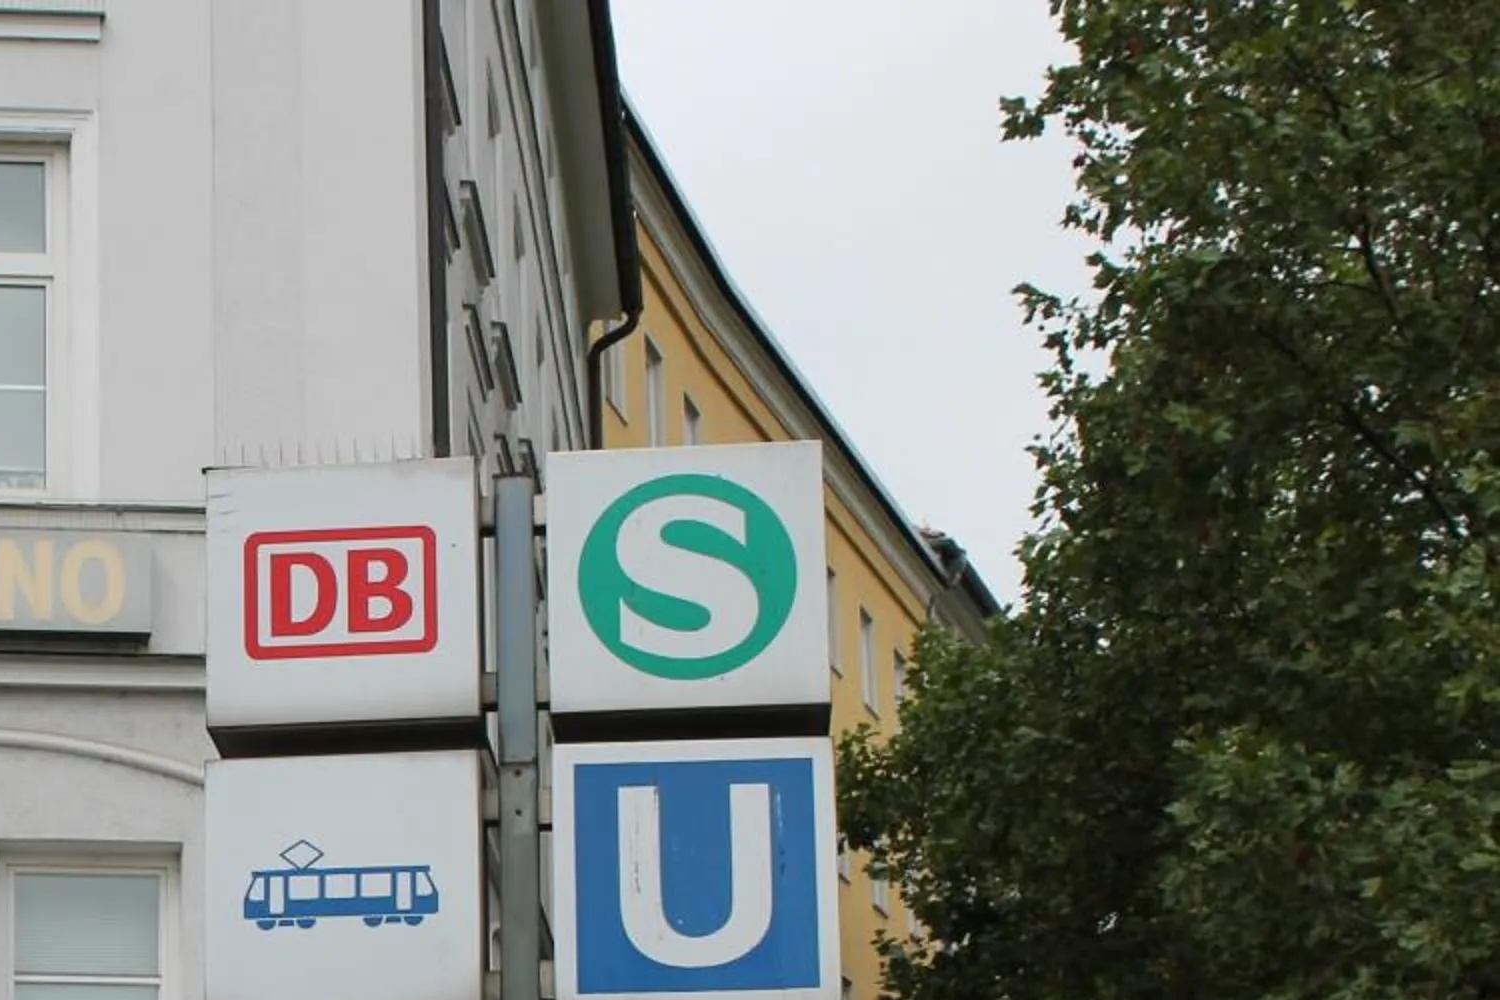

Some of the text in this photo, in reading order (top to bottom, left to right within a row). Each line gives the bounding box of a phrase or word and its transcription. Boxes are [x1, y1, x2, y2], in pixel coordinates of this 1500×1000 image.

[270, 548, 413, 638] DB
[616, 493, 759, 659] S
[618, 783, 773, 969] U
